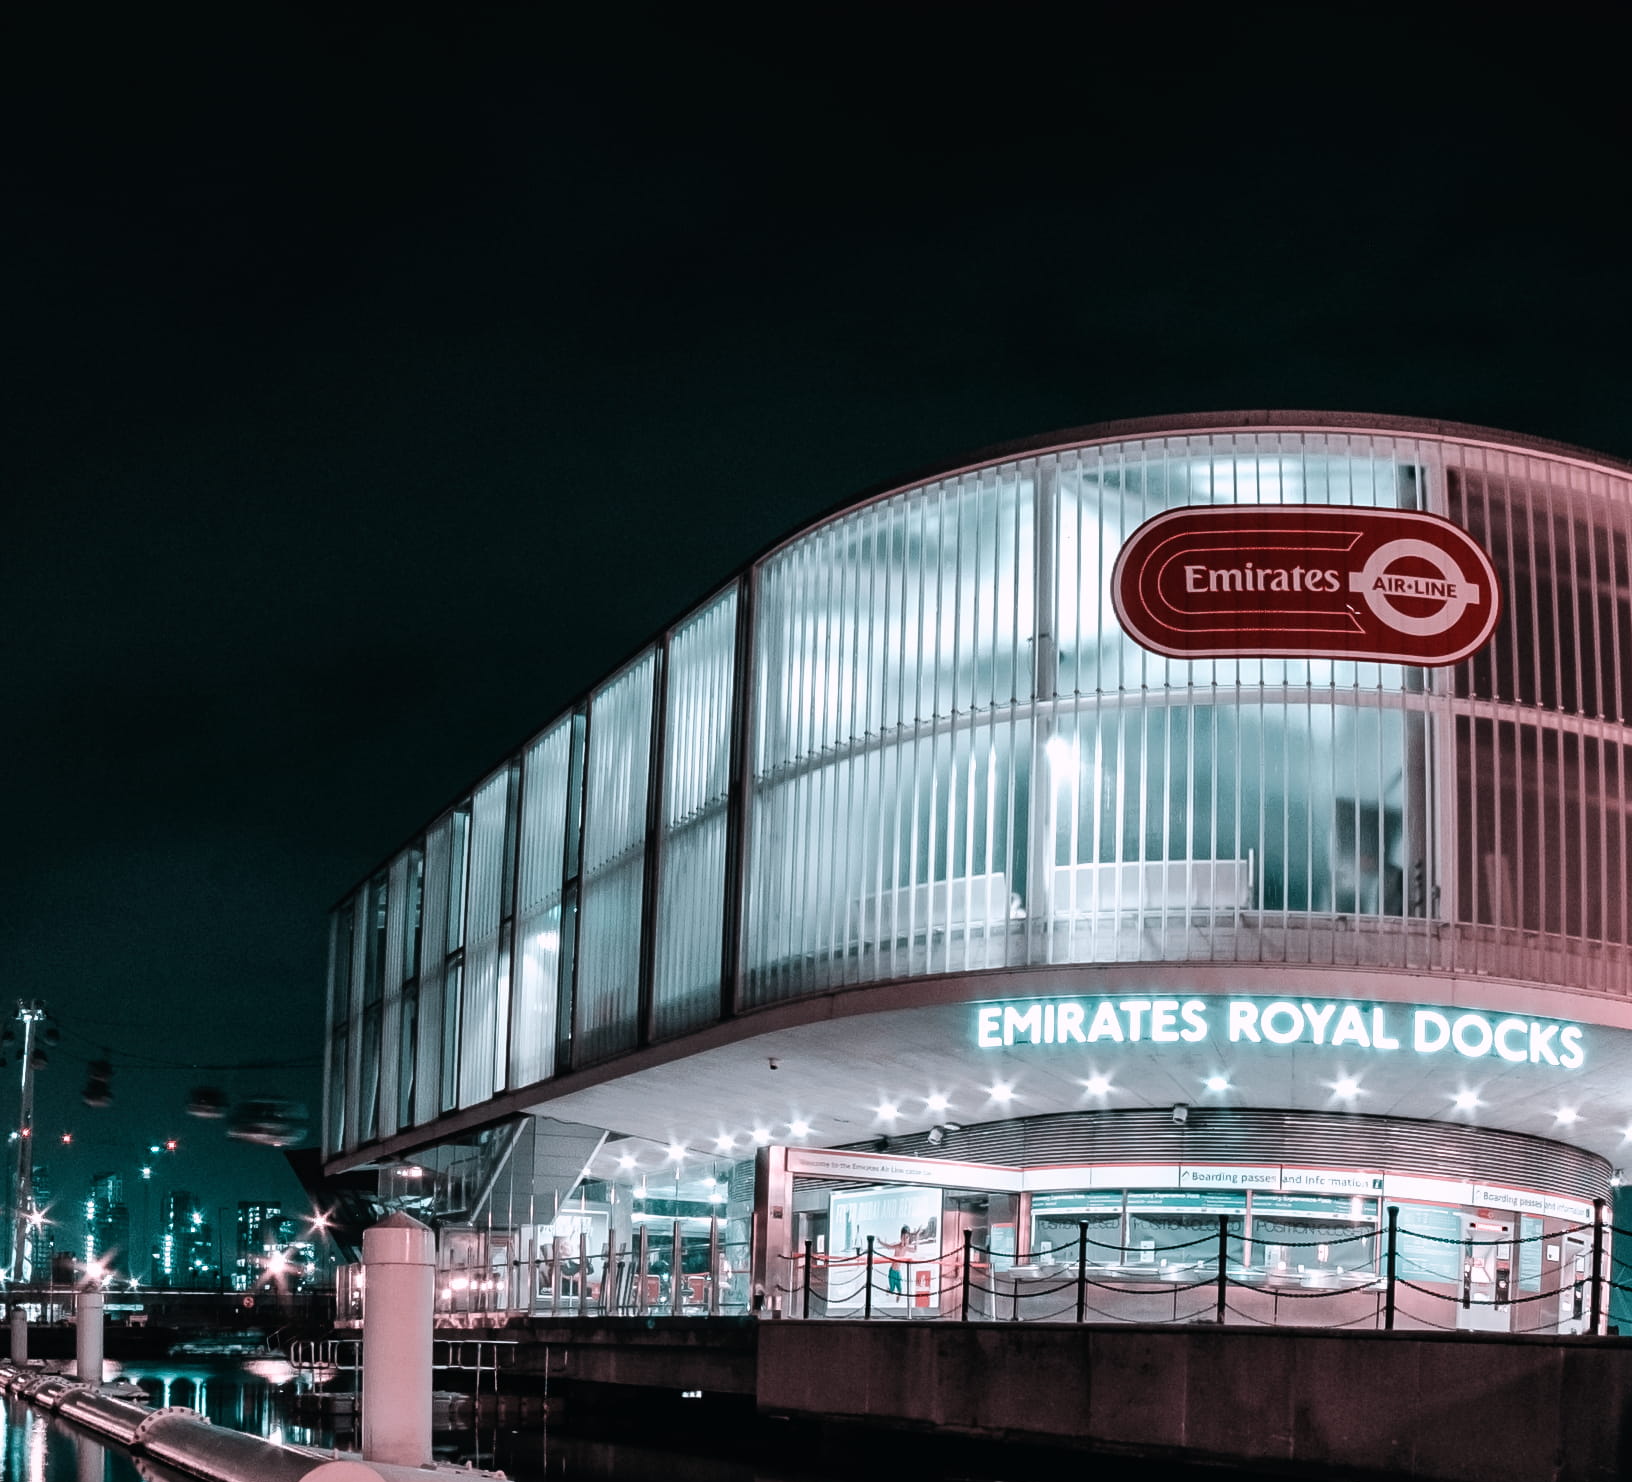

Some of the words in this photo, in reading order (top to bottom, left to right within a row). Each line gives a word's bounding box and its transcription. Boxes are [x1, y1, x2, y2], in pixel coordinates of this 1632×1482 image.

[1184, 562, 1340, 593] Emirates
[978, 1001, 1209, 1048] EMIRATES
[1229, 1001, 1401, 1051] ROYAL
[1414, 1010, 1584, 1069] DOCKS
[1192, 1171, 1238, 1184] Boarding
[1282, 1174, 1302, 1185] and
[1483, 1191, 1518, 1206] Boarding
